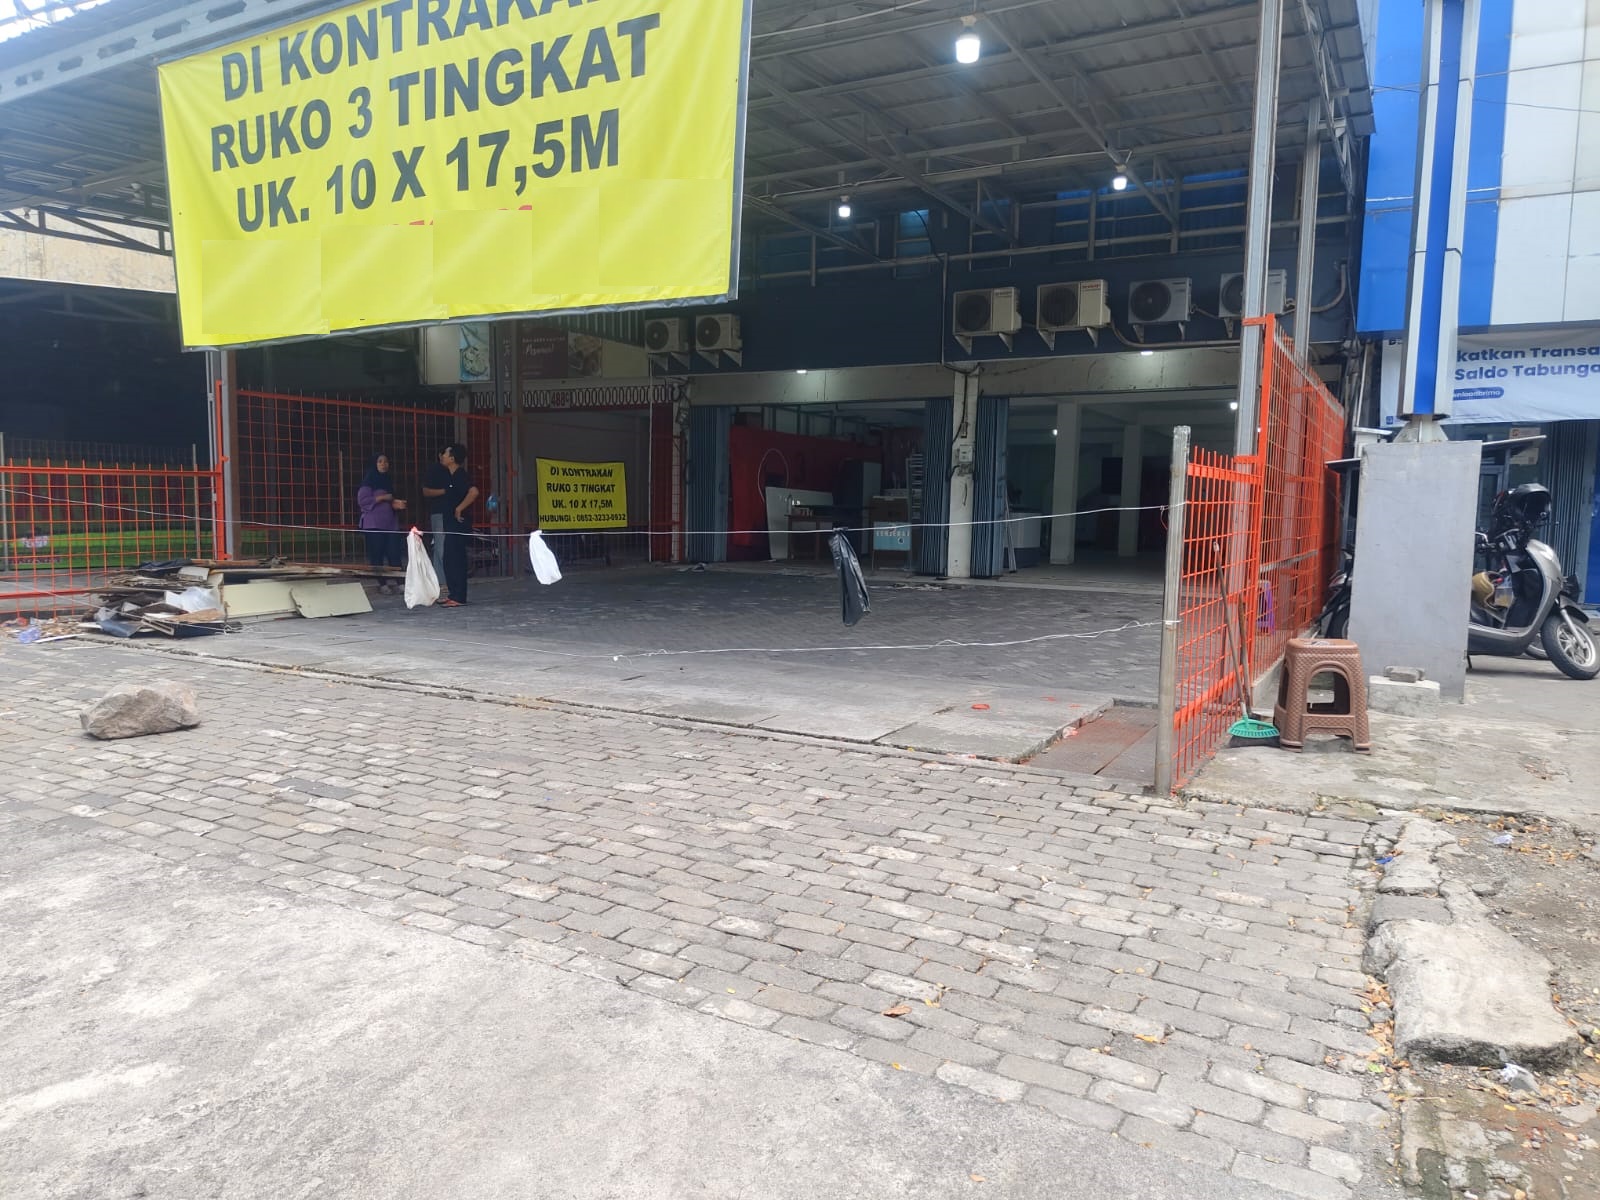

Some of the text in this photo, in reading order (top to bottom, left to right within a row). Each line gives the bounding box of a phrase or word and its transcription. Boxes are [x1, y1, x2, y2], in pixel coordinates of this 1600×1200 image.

[222, 45, 263, 102] DI
[211, 12, 660, 172] RUKO 3 TINGKAT
[237, 176, 309, 232] UK.
[326, 159, 376, 215] 10
[392, 145, 426, 202] X
[446, 108, 619, 196] 17,5M
[1457, 346, 1600, 363] katkan Transa
[1454, 363, 1600, 381] Saldo Tabunga
[550, 466, 613, 478] DI KONTRAKAN
[546, 483, 616, 493] RUKO 3 TINGKAT
[569, 499, 579, 508] 10
[581, 499, 587, 508] X
[589, 499, 613, 511] 17,5M
[540, 514, 571, 523] HUBUNGI
